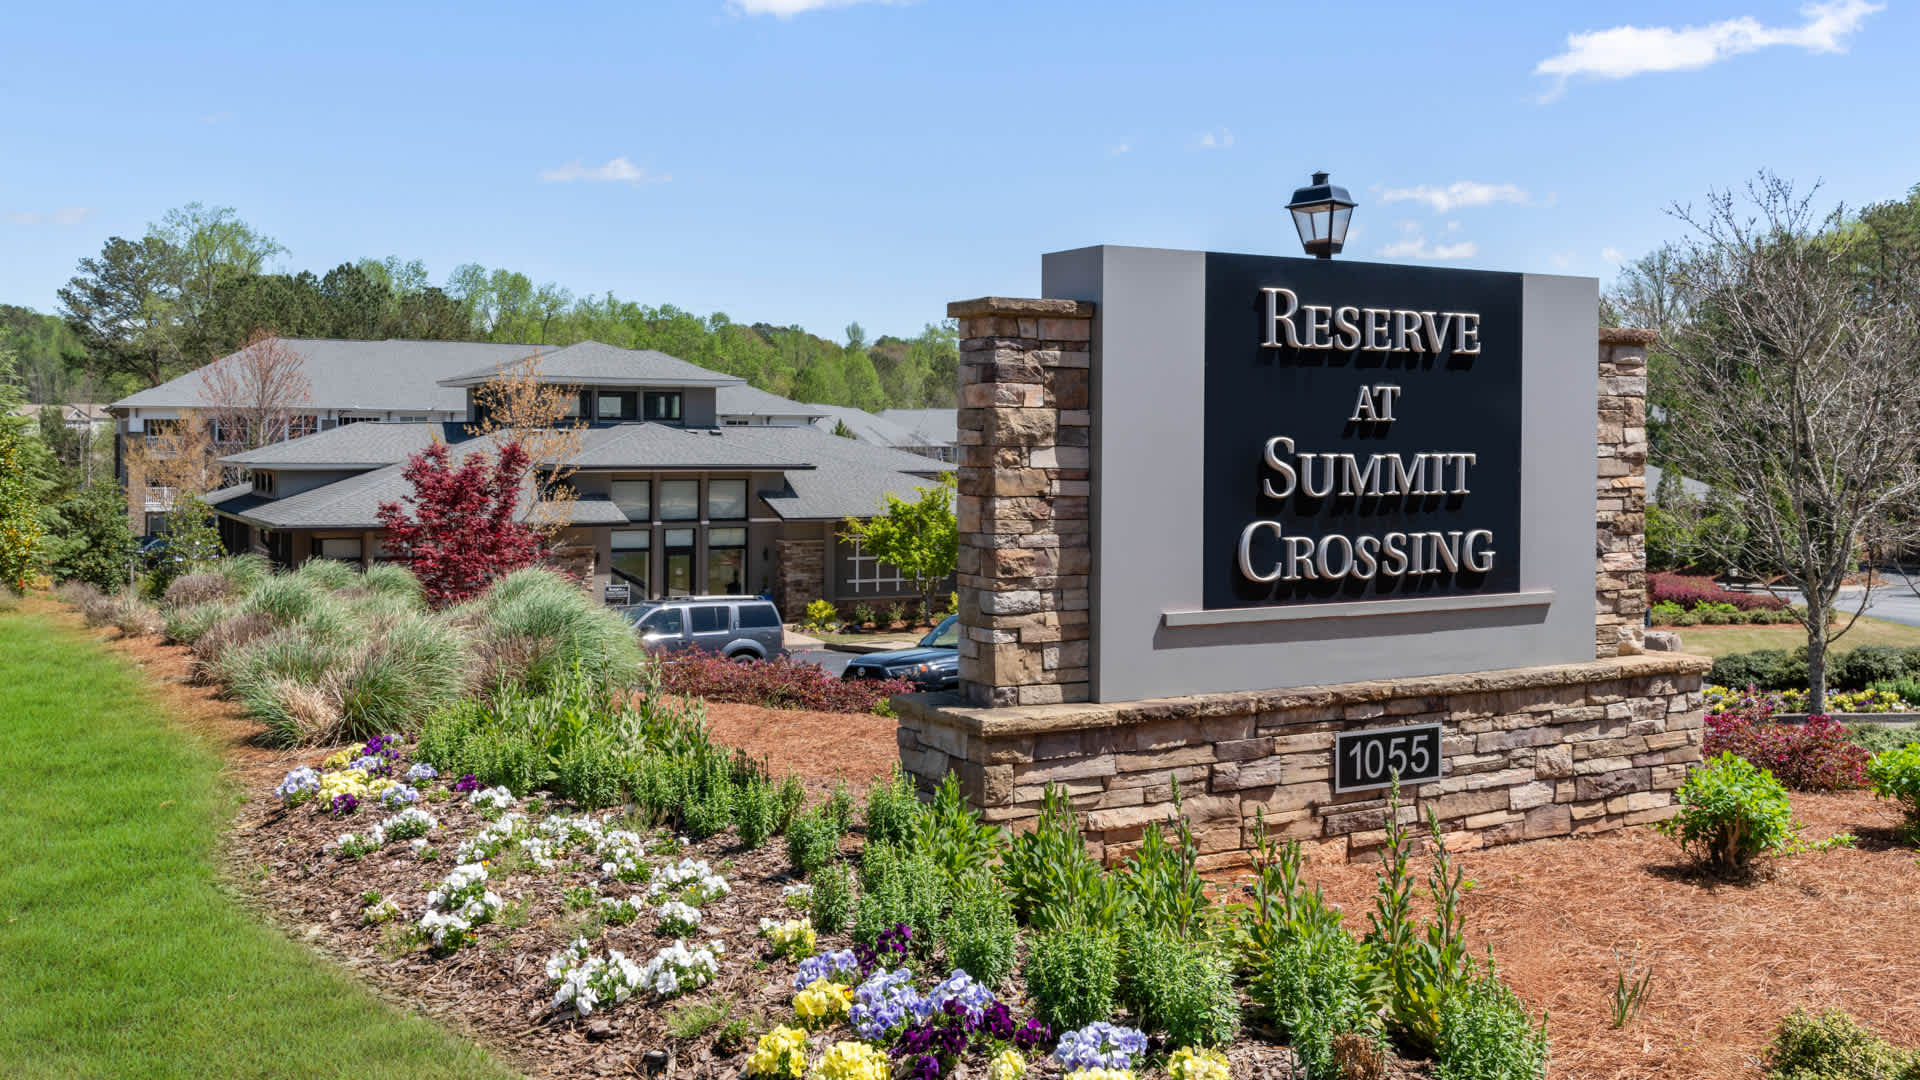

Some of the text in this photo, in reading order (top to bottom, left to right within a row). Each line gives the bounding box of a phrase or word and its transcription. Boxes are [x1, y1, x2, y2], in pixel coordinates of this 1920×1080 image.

[1260, 286, 1481, 354] RESERVE
[1349, 384, 1401, 422] AT
[1263, 436, 1477, 498] SUMMIT
[1238, 520, 1496, 583] CROSSING
[1350, 734, 1430, 780] 1055
